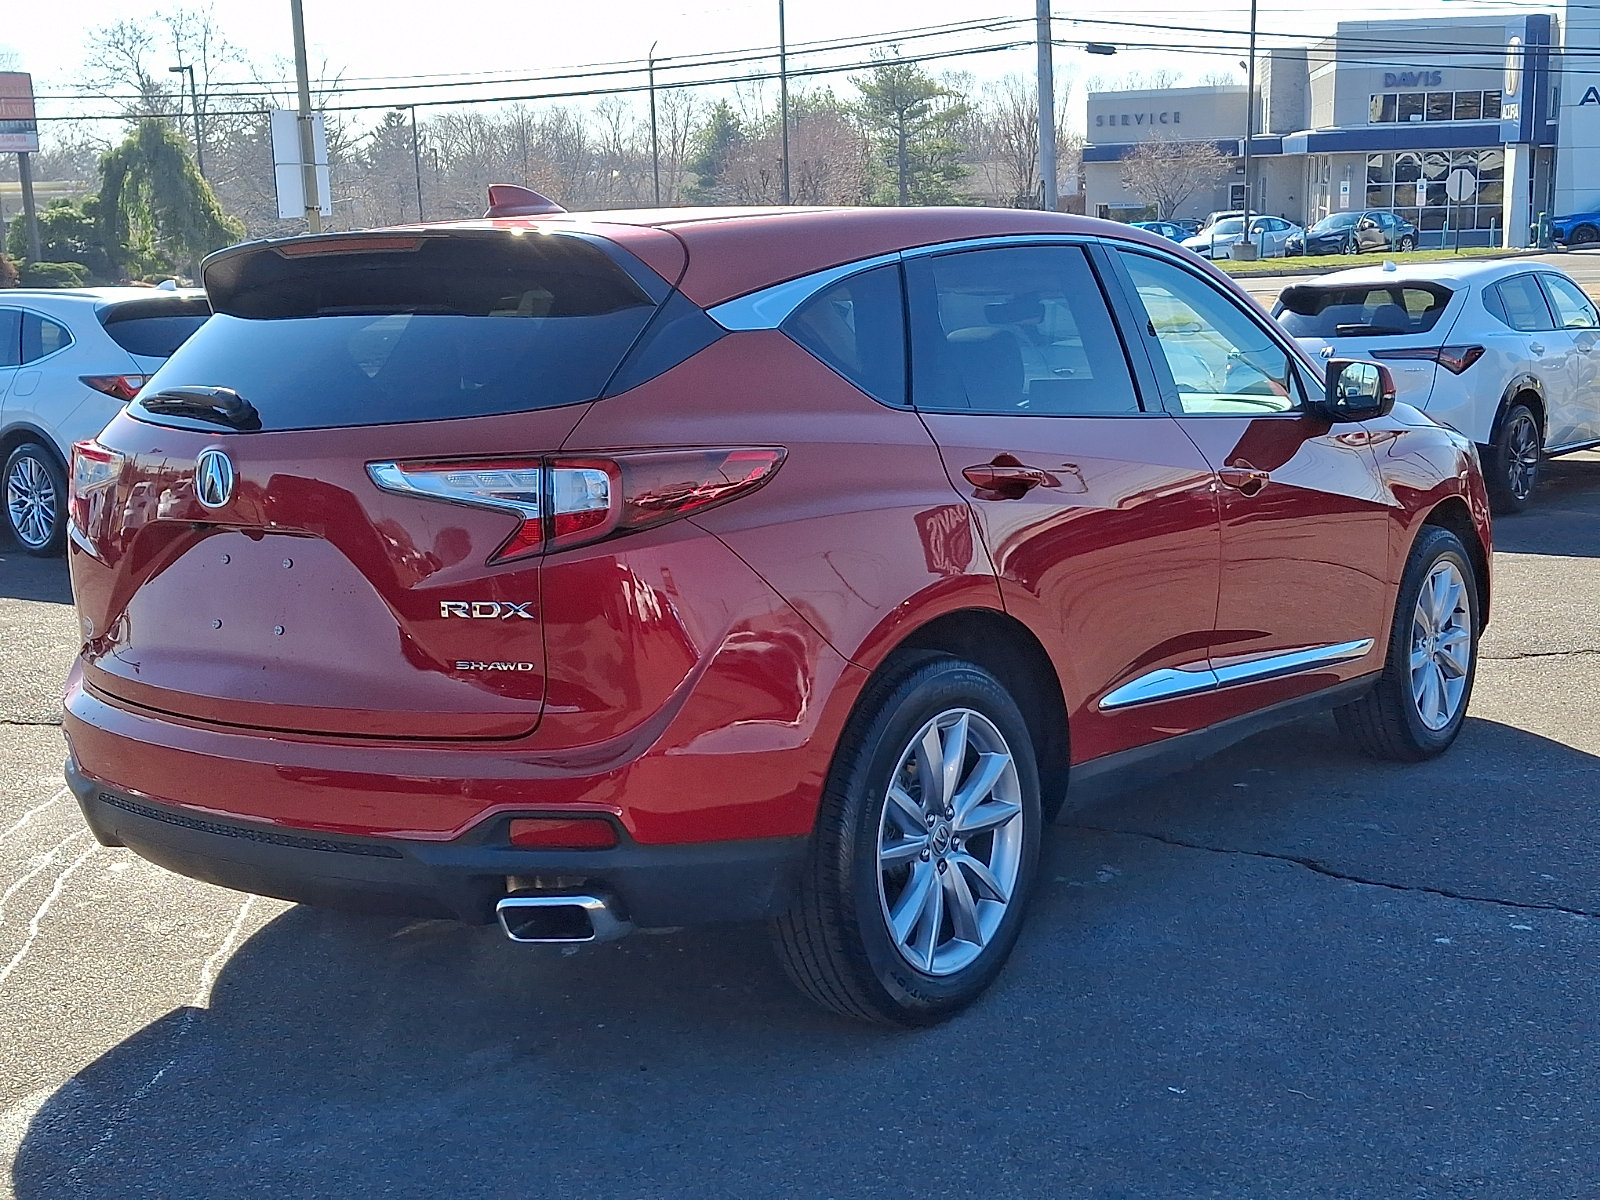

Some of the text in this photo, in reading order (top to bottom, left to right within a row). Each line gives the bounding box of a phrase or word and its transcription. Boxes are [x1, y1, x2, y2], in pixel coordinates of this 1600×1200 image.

[1384, 70, 1442, 88] DAVIS
[1096, 111, 1180, 127] SERVICE
[439, 600, 535, 620] RDX
